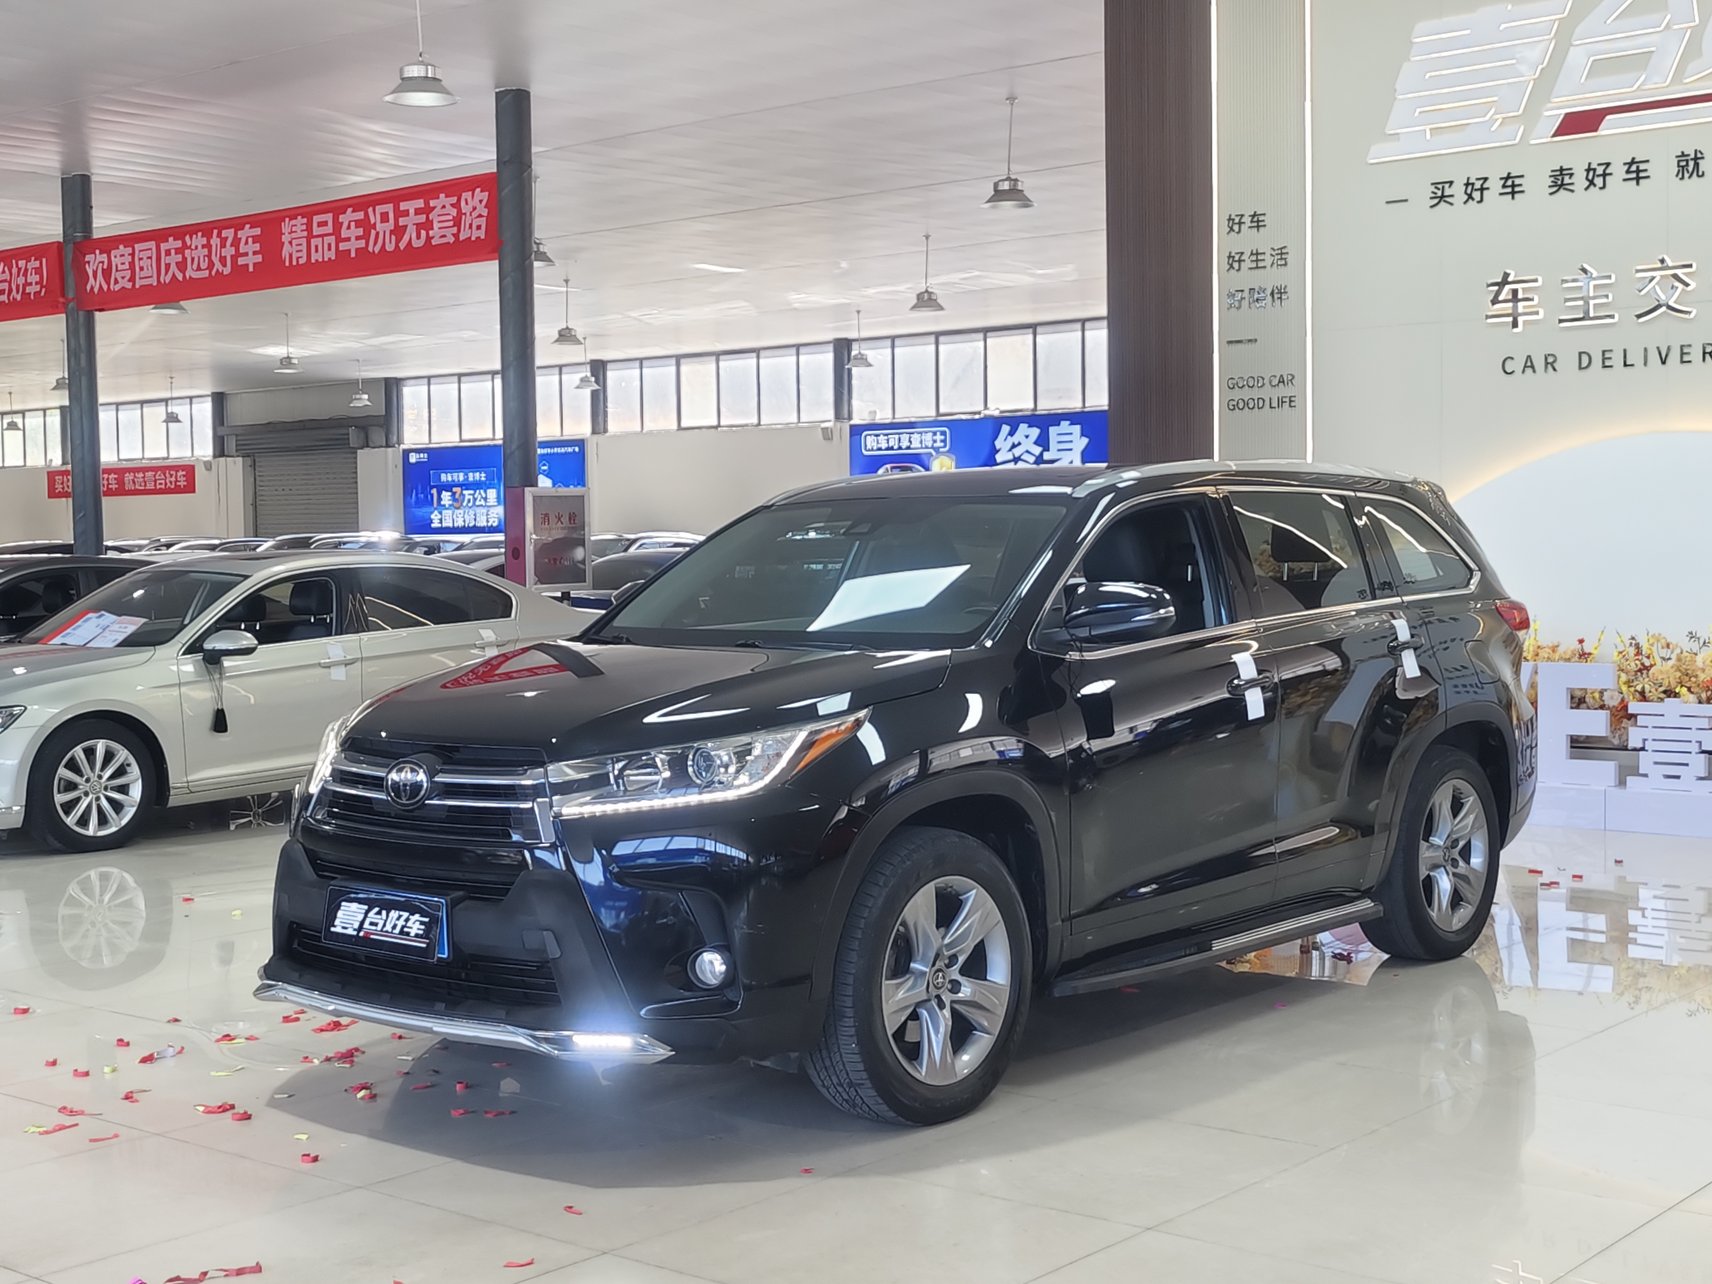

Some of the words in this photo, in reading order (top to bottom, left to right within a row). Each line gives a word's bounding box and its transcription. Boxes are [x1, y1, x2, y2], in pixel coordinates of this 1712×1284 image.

[1366, 0, 1712, 164] 壹台
[1429, 171, 1526, 209] 买好车
[1547, 156, 1651, 196] 卖好车
[1674, 149, 1706, 181] 就
[1226, 210, 1267, 235] 好车
[84, 223, 263, 295] 欢度国庆选好车
[281, 187, 489, 267] 精品车况无套路
[1226, 245, 1290, 272] 好生活
[1226, 283, 1290, 311] 好陪伴
[1485, 254, 1697, 333] 车主交
[1501, 353, 1558, 376] CAR
[1226, 375, 1266, 390] GOOD
[1268, 373, 1296, 388] CAR
[1226, 397, 1266, 412] GOOD
[1268, 395, 1297, 410] LIFE
[993, 420, 1090, 466] 终身
[124, 470, 187, 490] 就选壹台好车
[430, 486, 498, 509] 1年3万公里
[430, 509, 499, 529] 全国保修服务
[540, 511, 577, 526] 消火栓
[330, 901, 430, 938] 壹台好车
